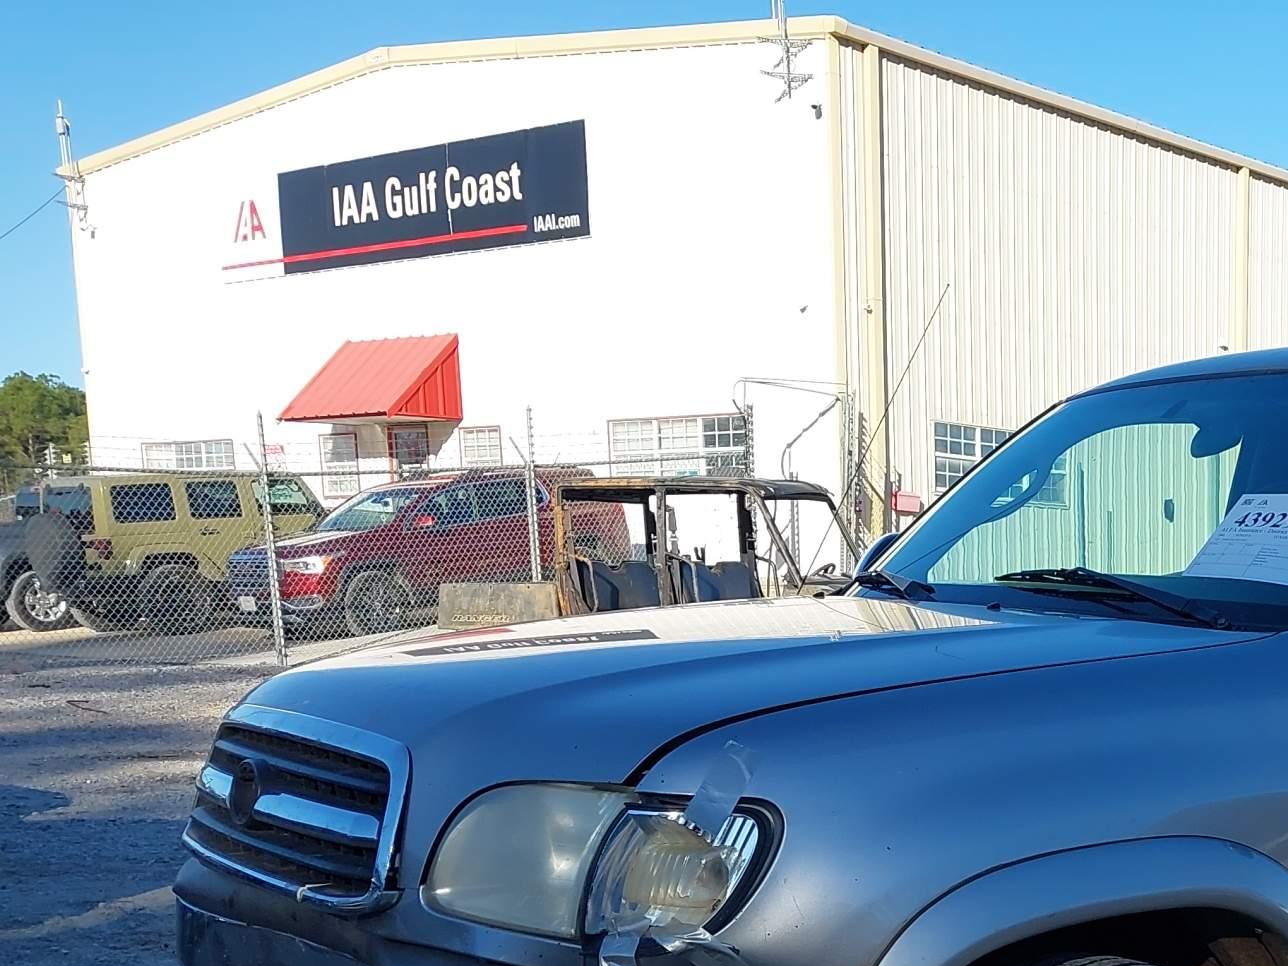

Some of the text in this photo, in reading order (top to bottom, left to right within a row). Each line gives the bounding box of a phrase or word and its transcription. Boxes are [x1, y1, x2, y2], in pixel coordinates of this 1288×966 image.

[332, 161, 523, 227] IAA Gulf Coast
[533, 213, 581, 233] IAAI.com
